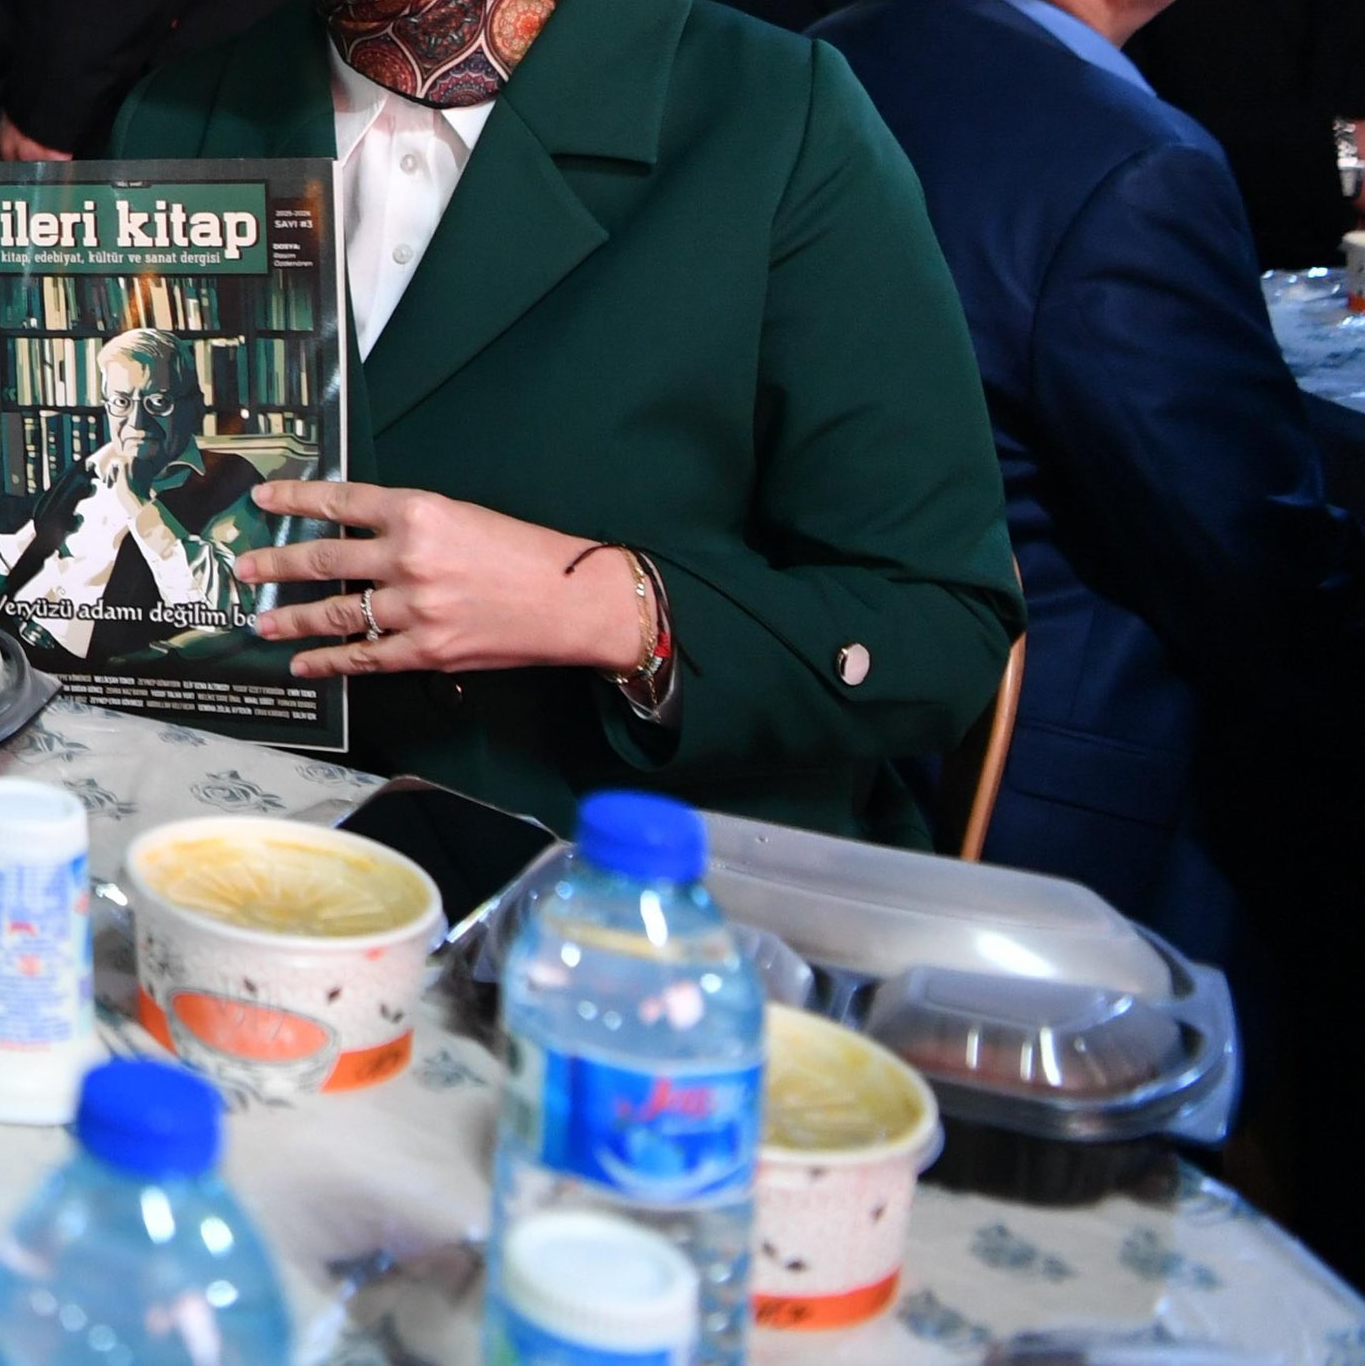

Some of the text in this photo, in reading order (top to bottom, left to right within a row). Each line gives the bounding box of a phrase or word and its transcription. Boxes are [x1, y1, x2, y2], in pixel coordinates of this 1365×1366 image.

[0, 200, 257, 259] ileri kitap
[274, 220, 298, 228] SAYI
[1, 251, 221, 266] kitap, edebiyat, kültür ve sanat dergisi
[79, 600, 143, 621] adamı
[149, 601, 231, 628] değilim
[233, 604, 256, 627] be
